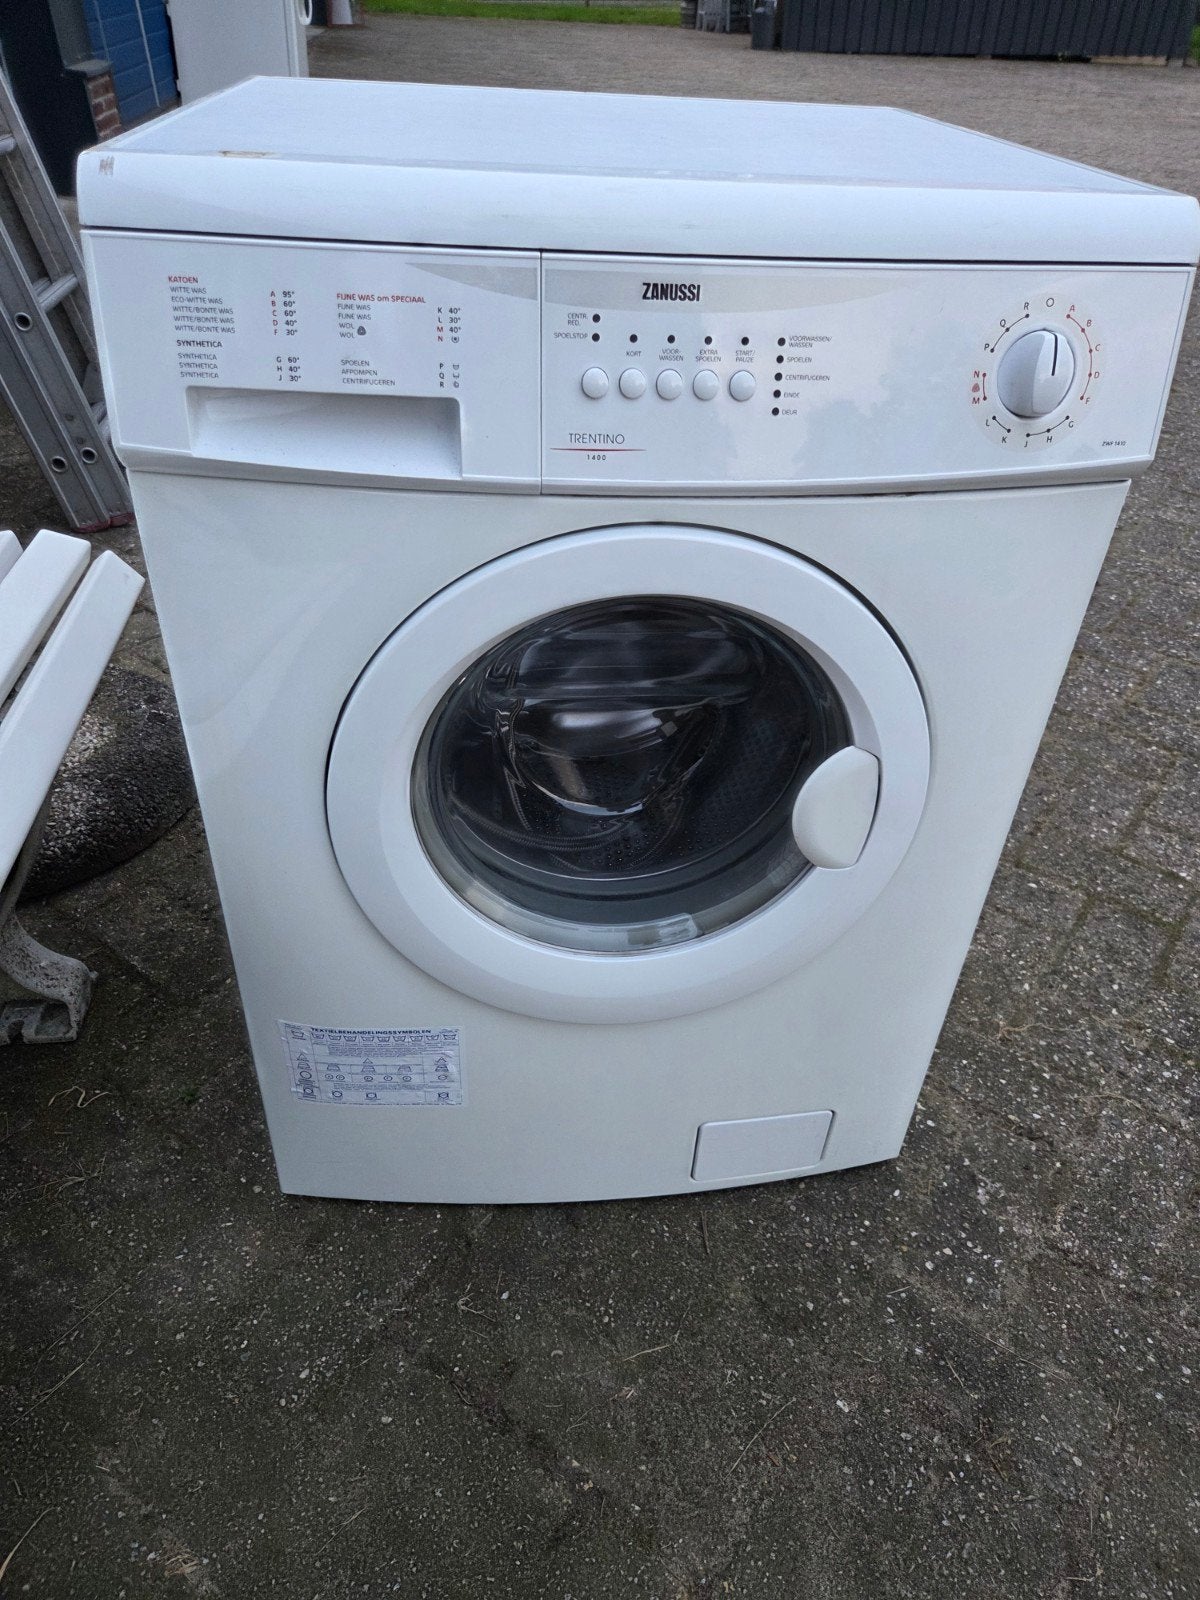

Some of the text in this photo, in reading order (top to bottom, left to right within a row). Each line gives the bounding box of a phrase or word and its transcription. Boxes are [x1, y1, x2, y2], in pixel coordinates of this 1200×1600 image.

[168, 275, 198, 284] KATOEN
[170, 286, 189, 294] WITTE
[270, 290, 276, 298] A
[642, 282, 701, 301] ZANUSSI
[358, 294, 375, 302] WAS
[391, 295, 426, 304] SPECIAAL
[1023, 302, 1030, 311] R
[1068, 304, 1076, 313] A
[219, 307, 233, 315] WAS
[220, 316, 235, 324] WAS
[357, 313, 372, 321] WAS
[273, 319, 278, 327] D
[338, 322, 355, 330] WOL
[999, 318, 1007, 328] Q
[1086, 319, 1093, 327] B
[221, 325, 236, 334] WAS
[176, 339, 223, 348] SYNTHETICA
[984, 343, 990, 351] P
[1095, 343, 1101, 352] C
[178, 352, 217, 361] SYNTHETICA
[179, 361, 218, 370] SYNTHETICA
[340, 359, 370, 367] SPOELEN
[439, 362, 444, 370] P
[180, 371, 219, 379] SYNTHETICA
[438, 372, 445, 380] Q
[785, 374, 831, 382] CENTRIFUGEREN
[973, 370, 980, 378] N
[1094, 371, 1100, 379] D
[342, 377, 396, 386] CENTRIFUGEREN
[1085, 397, 1091, 405] F
[985, 419, 991, 427] L
[568, 433, 625, 445] TRENTINO
[1001, 436, 1008, 444] K
